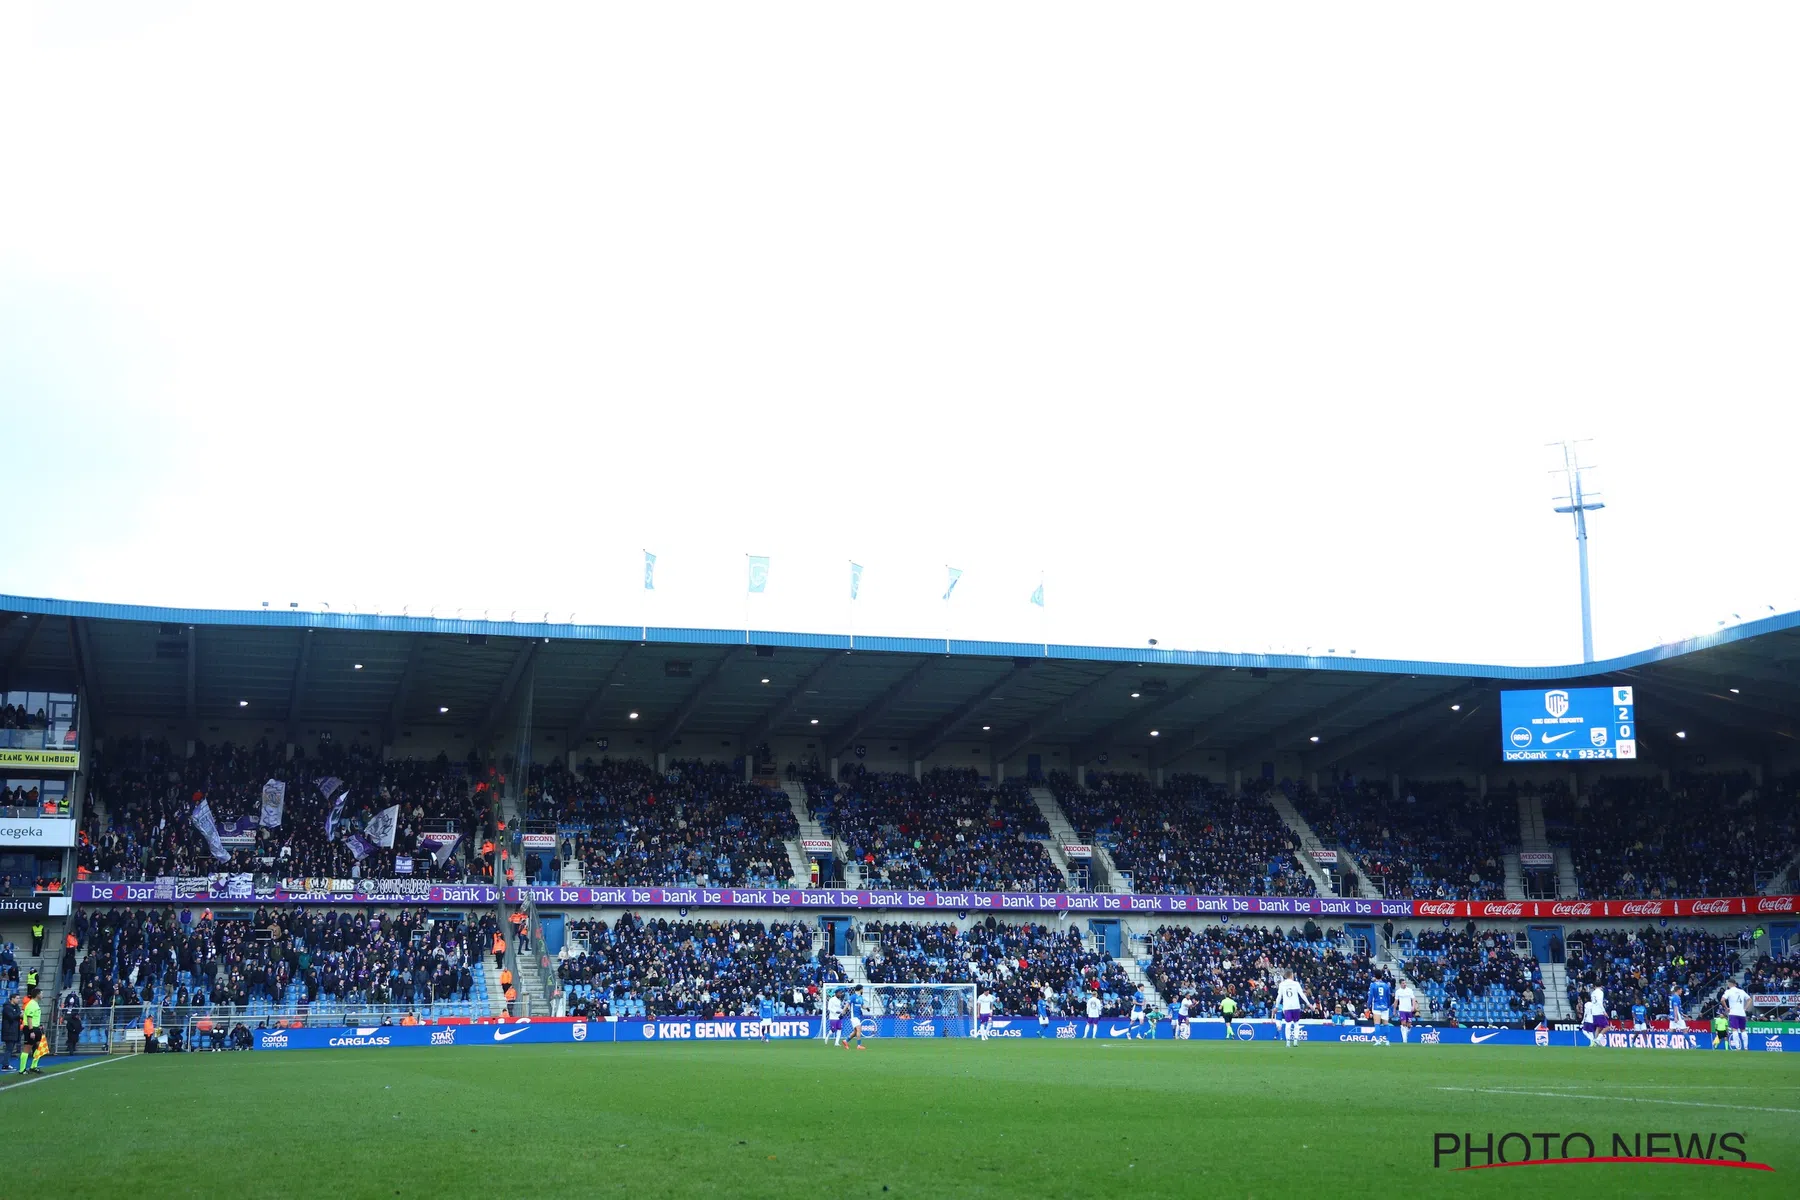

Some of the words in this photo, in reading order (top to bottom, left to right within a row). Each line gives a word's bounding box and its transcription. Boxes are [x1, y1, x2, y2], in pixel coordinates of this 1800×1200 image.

[1619, 707, 1629, 720] 2
[1620, 725, 1630, 738] 0
[42, 755, 75, 763] LIMBURG
[1579, 749, 1613, 759] 93:24
[0, 826, 43, 839] cegeka
[1285, 988, 1293, 998] 6
[1378, 987, 1384, 995] 9
[1736, 995, 1742, 1004] 4
[1754, 995, 1780, 1003] MECONA
[659, 1023, 690, 1039] KRC
[695, 1022, 736, 1038] GENK
[262, 1034, 287, 1042] corda
[329, 1037, 390, 1046] CARGLASS
[1609, 1033, 1627, 1048] KRC
